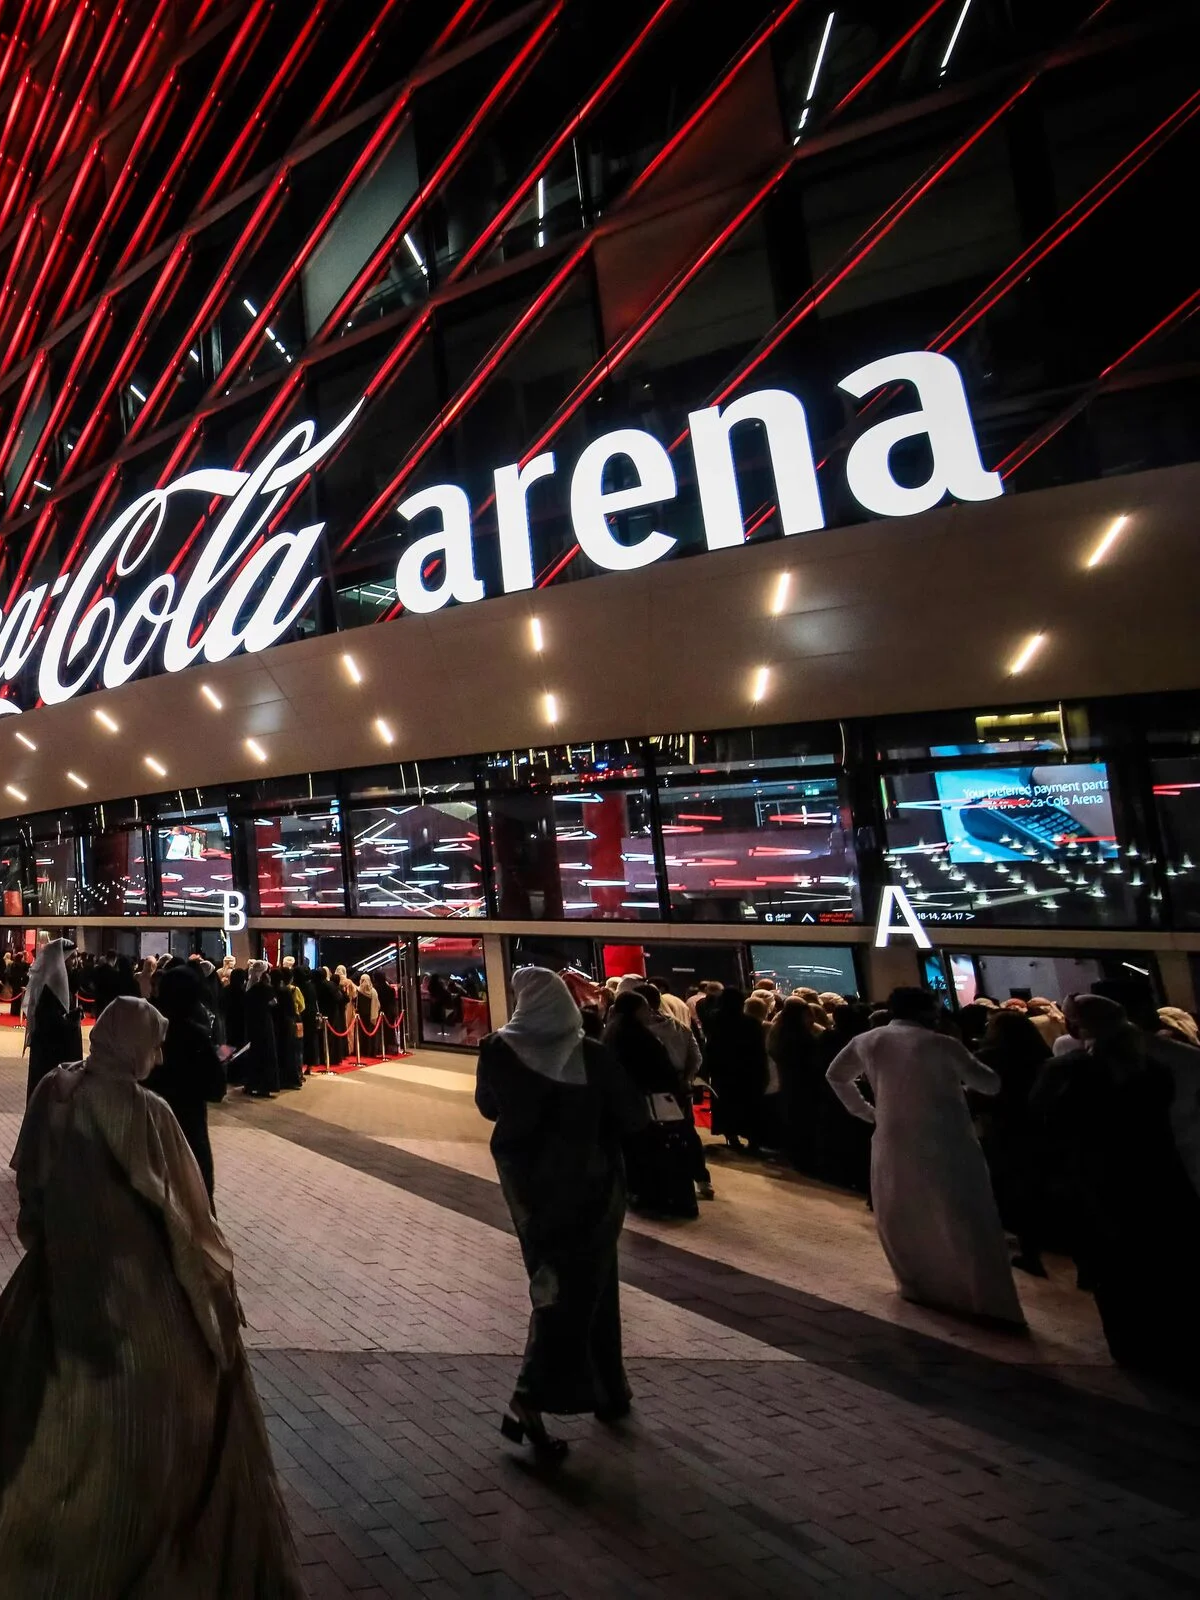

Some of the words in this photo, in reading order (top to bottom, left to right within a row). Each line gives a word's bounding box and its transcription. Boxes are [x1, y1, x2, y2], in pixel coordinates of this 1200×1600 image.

[394, 351, 1005, 614] arena
[963, 787, 986, 799] Your
[987, 784, 1032, 799] preferred
[1034, 781, 1080, 796] payment
[1017, 795, 1069, 809] Coca-Cola
[1072, 794, 1104, 806] Arena
[224, 890, 246, 931] B
[875, 886, 932, 949] A
